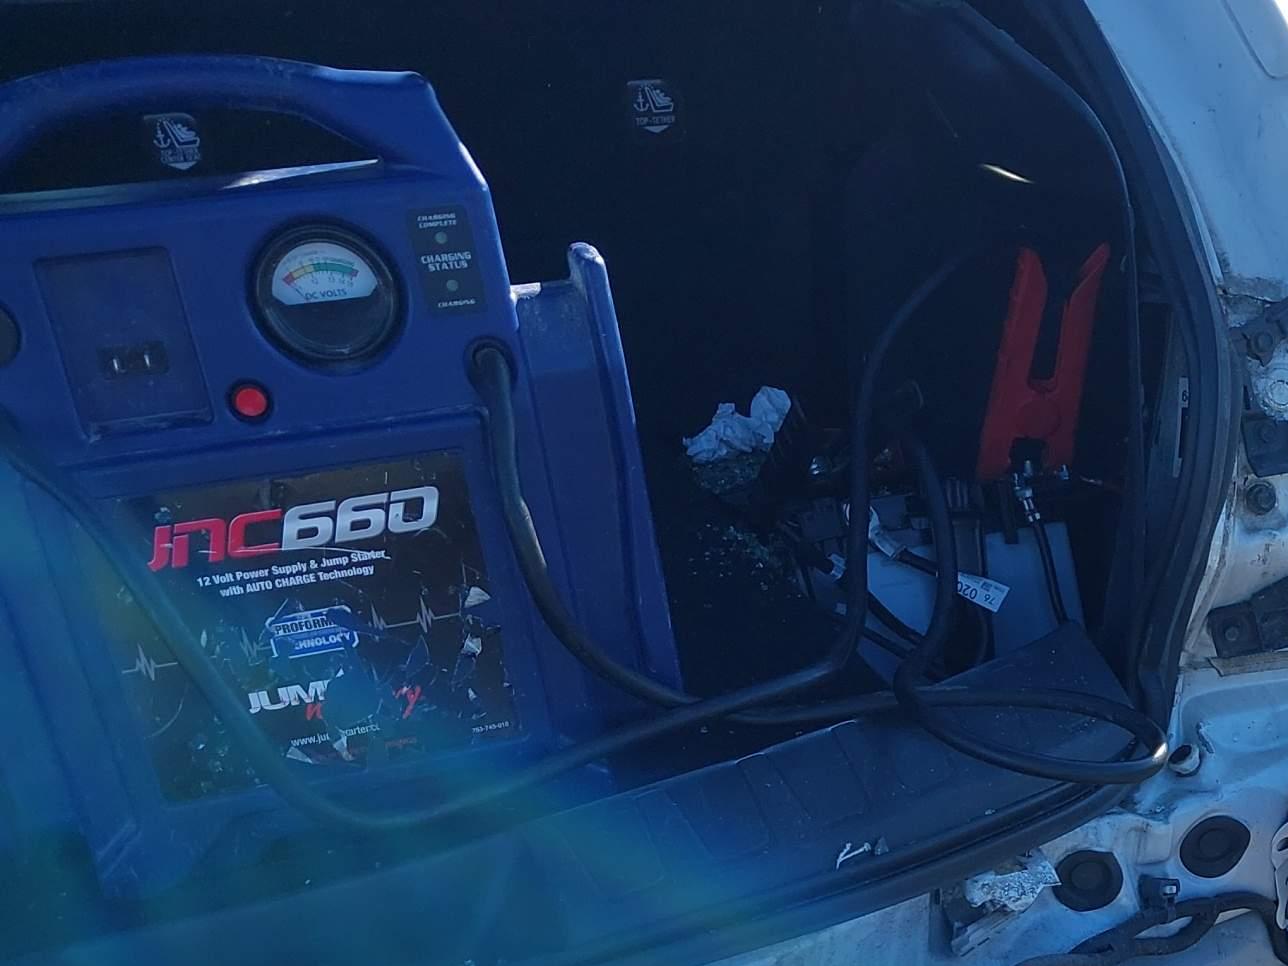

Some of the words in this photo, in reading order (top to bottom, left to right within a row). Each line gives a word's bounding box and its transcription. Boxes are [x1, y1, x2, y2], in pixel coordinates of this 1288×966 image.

[417, 213, 456, 222] CHARGING
[419, 220, 457, 229] COMPLETE
[421, 251, 472, 264] CHARGING
[428, 261, 468, 272] STATUS
[320, 288, 347, 298] VOLTS
[438, 299, 476, 308] CHARGING
[197, 577, 211, 587] 12
[212, 572, 234, 585] Volt
[235, 568, 269, 581] Power
[271, 561, 307, 575] Supply
[309, 559, 318, 569] &
[320, 556, 349, 567] Jump
[350, 550, 385, 562] Starter
[220, 585, 244, 597] with
[246, 580, 272, 593] AUTO
[274, 573, 316, 588] CHARGE
[317, 565, 374, 581] Technology
[275, 617, 336, 635] PROFORM
[248, 679, 331, 714] JUM
